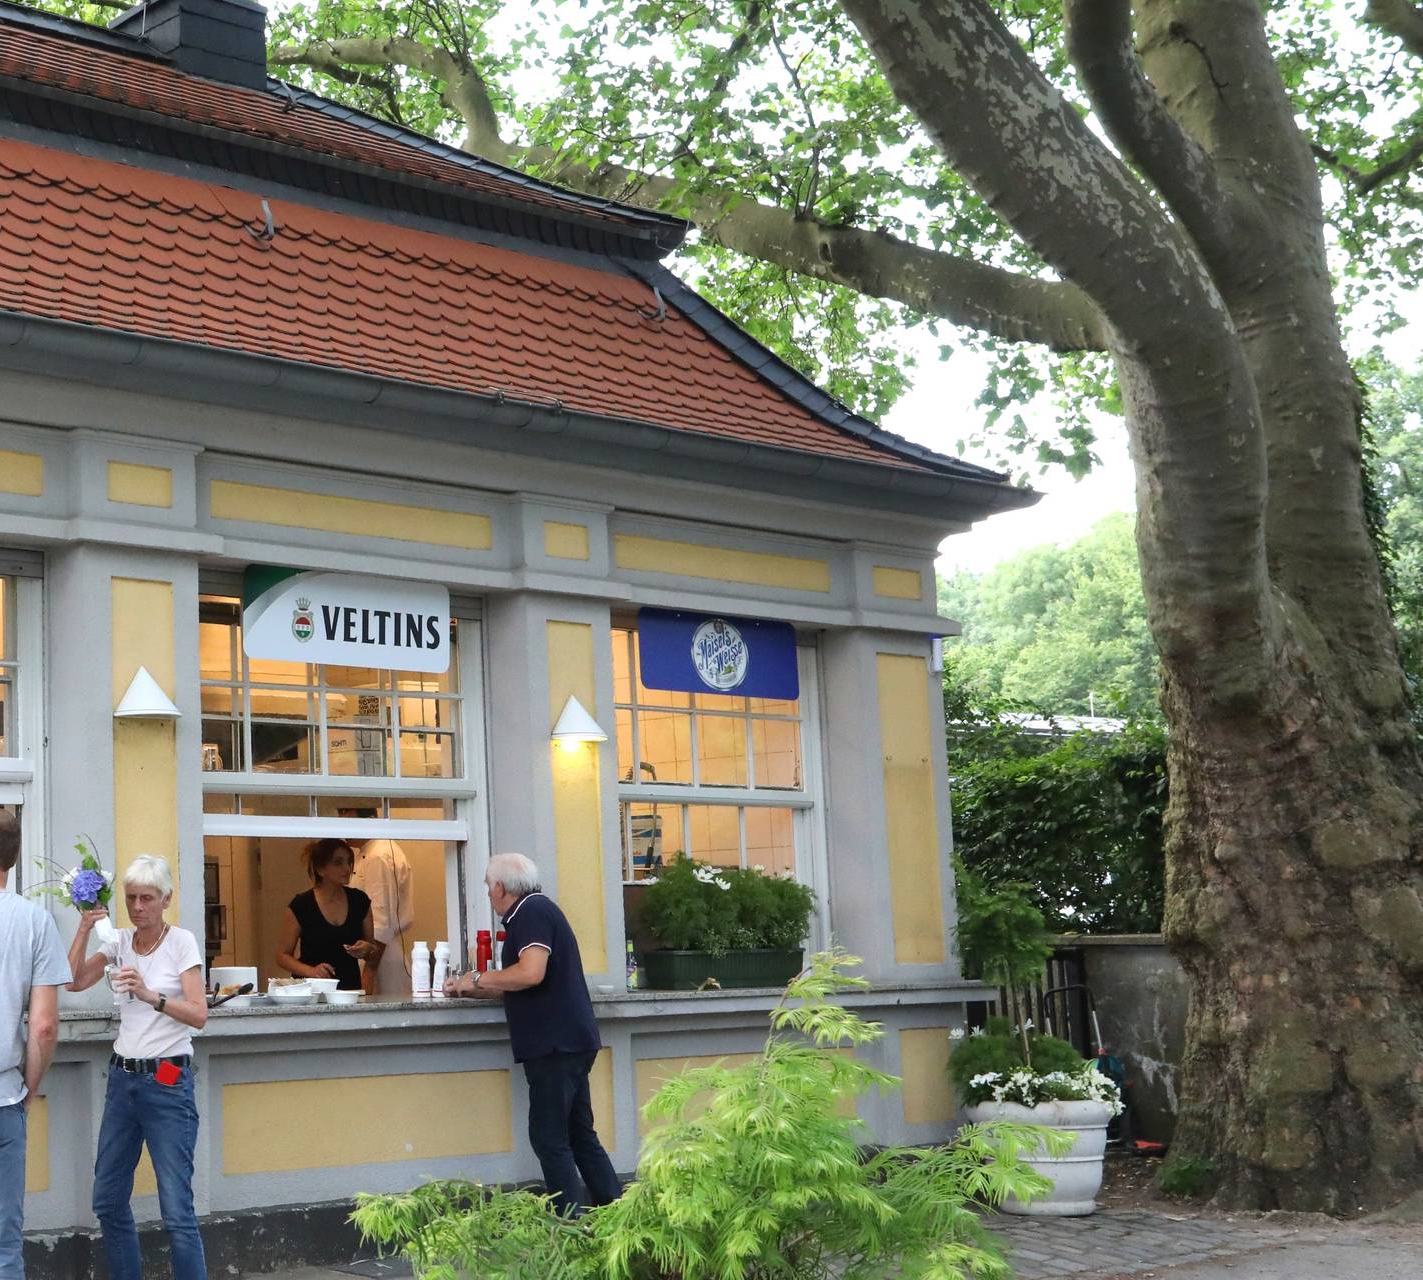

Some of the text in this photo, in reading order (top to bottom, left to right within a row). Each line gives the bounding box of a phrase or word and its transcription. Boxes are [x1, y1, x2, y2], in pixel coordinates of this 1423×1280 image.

[321, 605, 440, 650] VELTINS
[697, 627, 732, 670] Maisel's
[713, 641, 743, 673] Weisse
